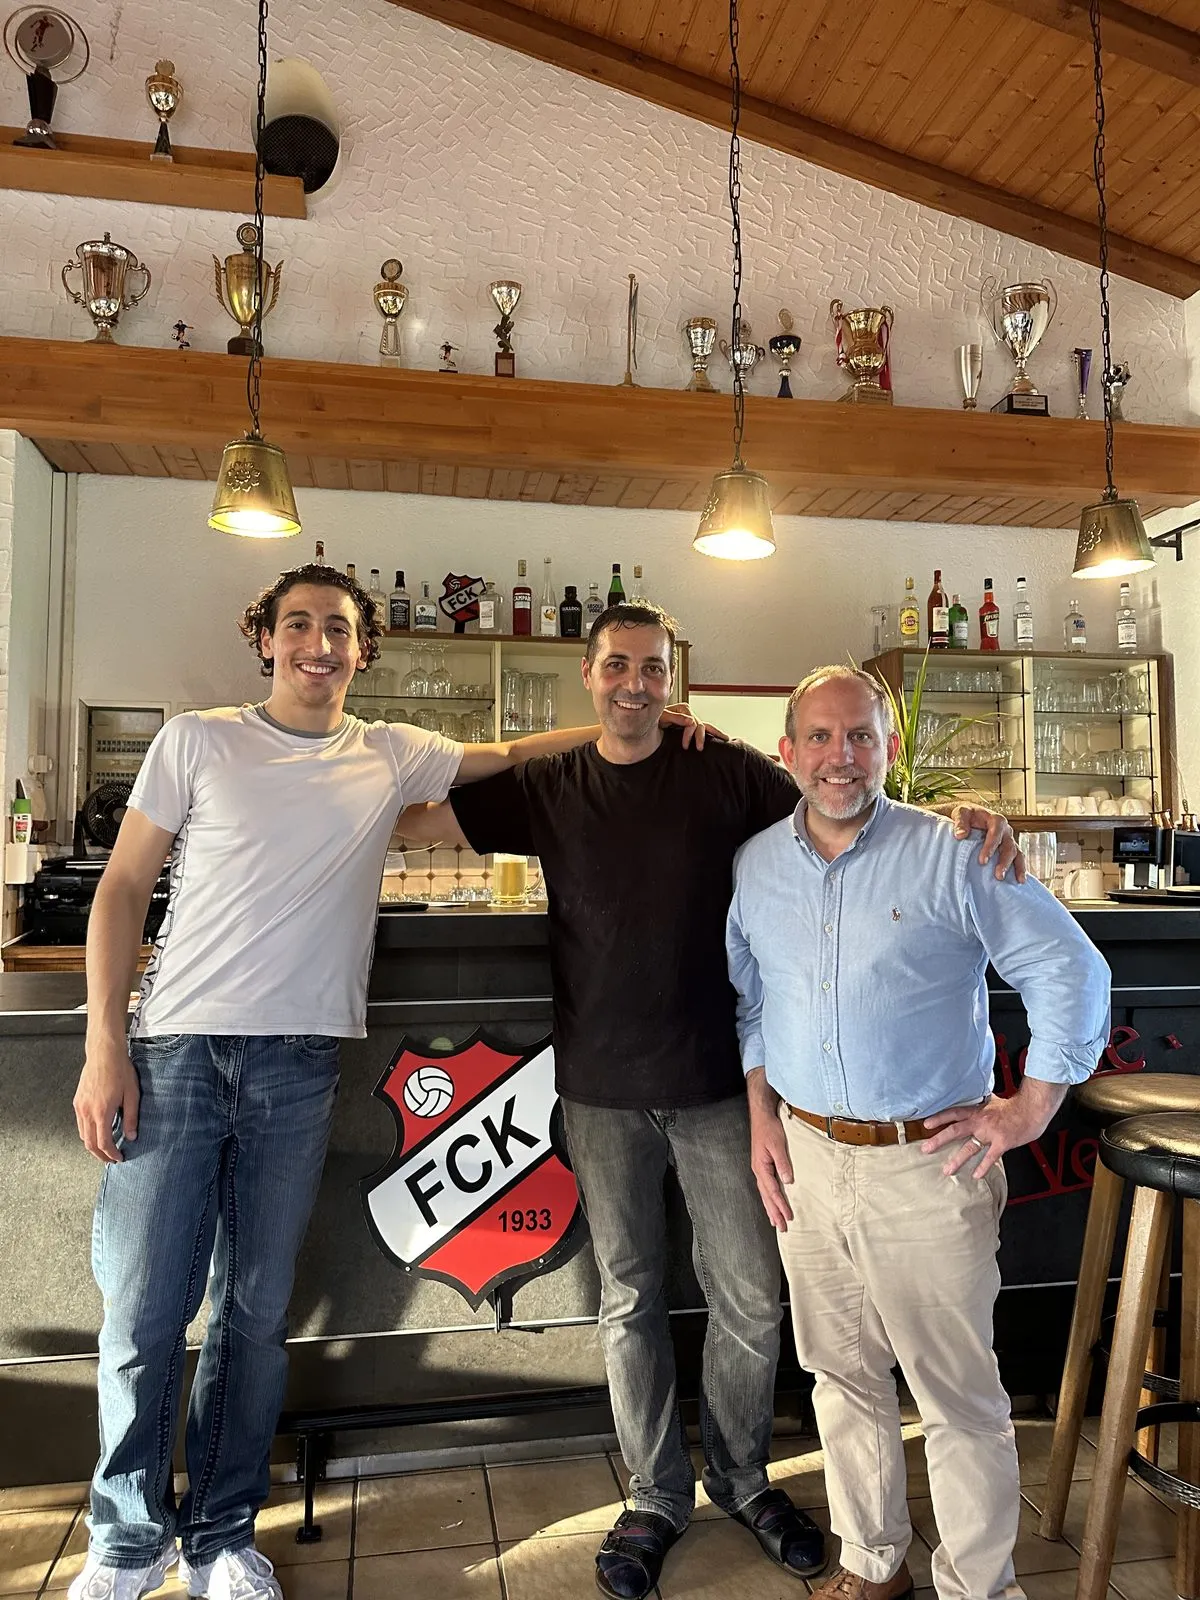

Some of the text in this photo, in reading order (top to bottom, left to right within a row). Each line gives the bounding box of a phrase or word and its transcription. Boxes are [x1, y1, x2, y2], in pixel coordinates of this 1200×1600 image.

[447, 586, 478, 611] FCK
[404, 1094, 541, 1228] FCK
[1028, 1129, 1099, 1192] Ve
[498, 1208, 552, 1233] 1933
